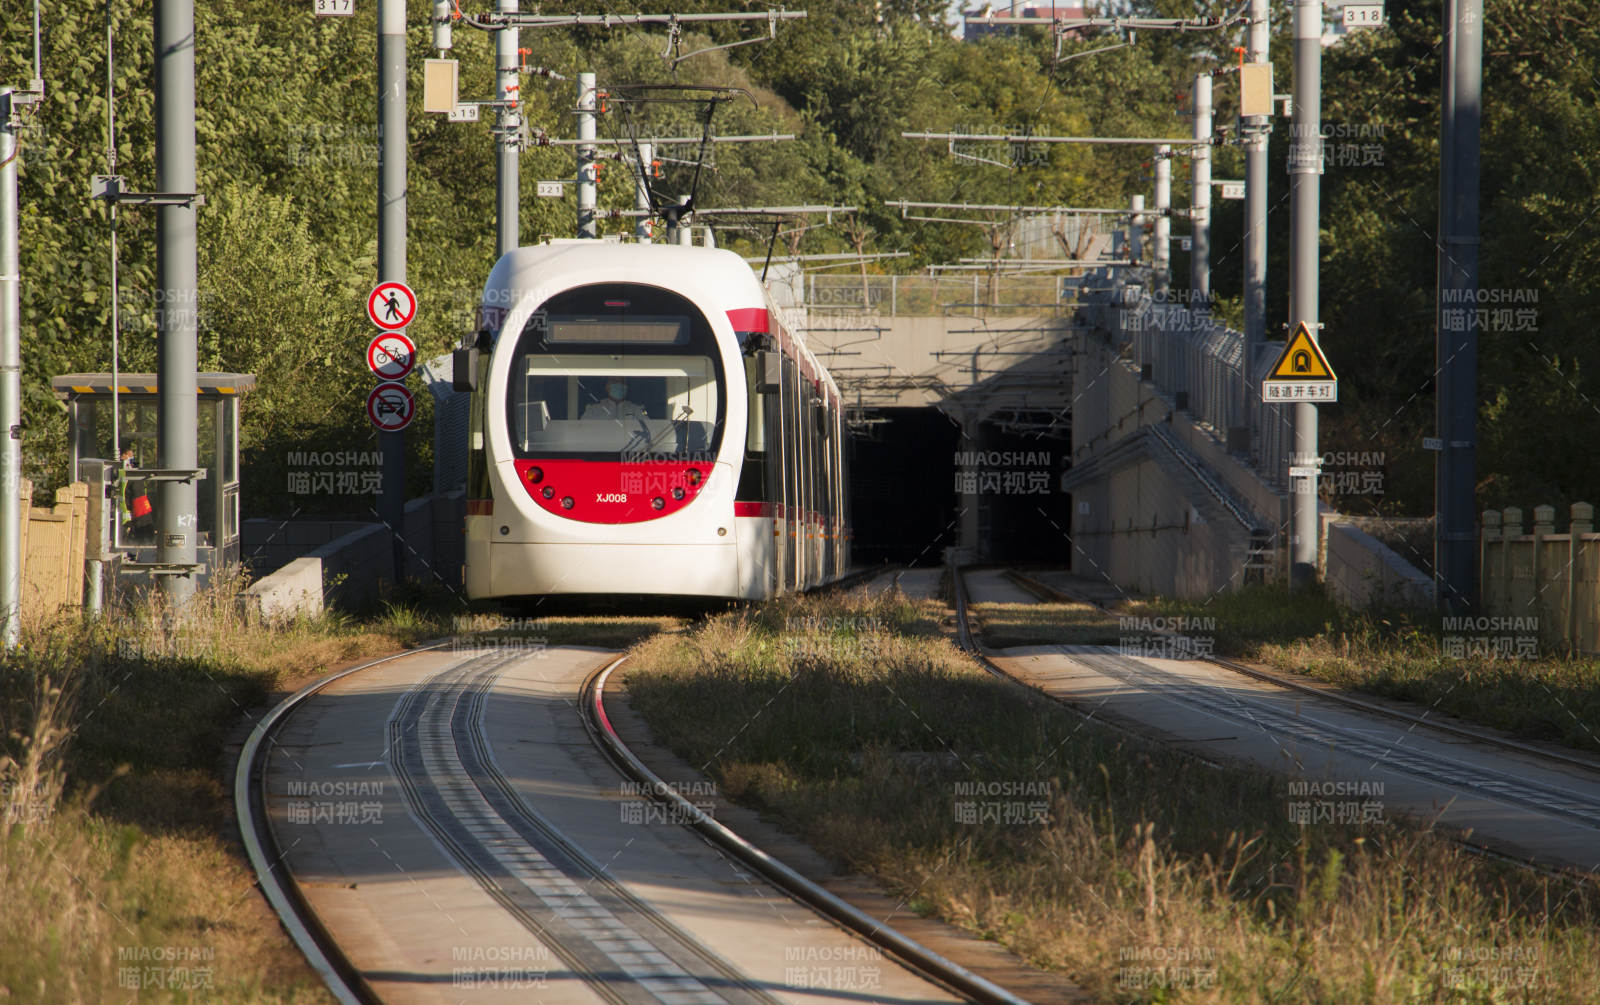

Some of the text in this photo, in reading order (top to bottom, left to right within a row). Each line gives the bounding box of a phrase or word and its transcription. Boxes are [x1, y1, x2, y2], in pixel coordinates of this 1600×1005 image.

[318, 0, 350, 10] 317
[1347, 11, 1379, 21] 318
[1269, 385, 1331, 398] 隧道开车灯
[596, 493, 627, 503] XJ008
